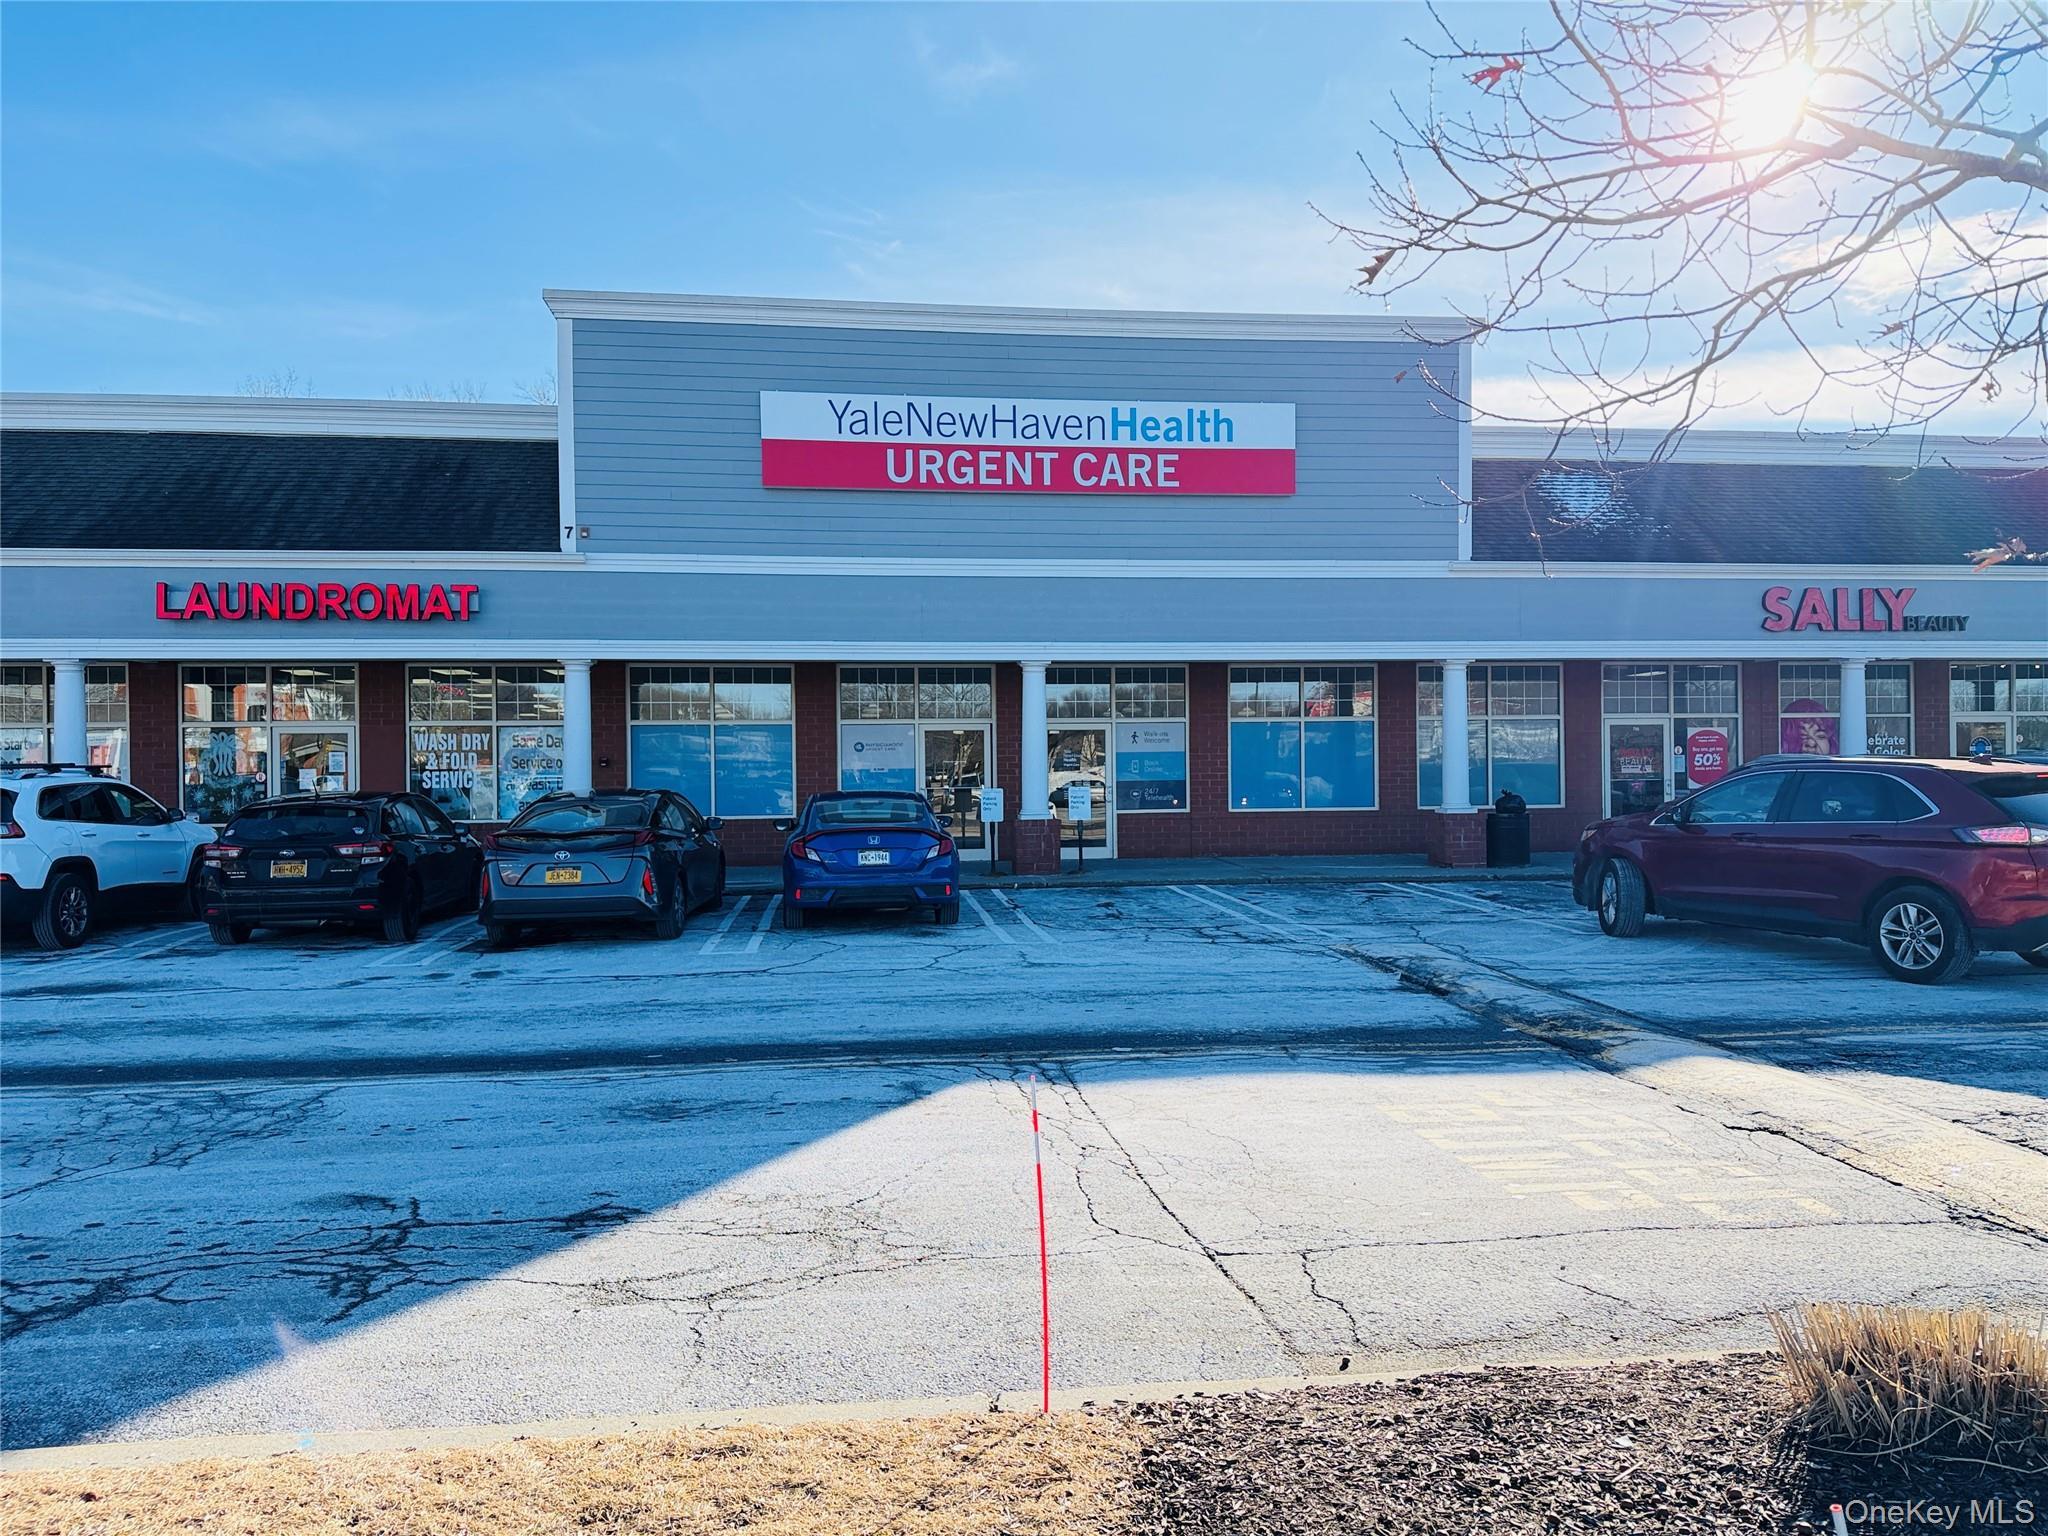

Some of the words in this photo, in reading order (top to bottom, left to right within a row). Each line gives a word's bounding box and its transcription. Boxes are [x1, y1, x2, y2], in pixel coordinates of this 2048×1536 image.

[886, 448, 1059, 486] URGENT
[1073, 453, 1180, 487] CARE
[564, 526, 573, 539] 7
[156, 582, 478, 621] LAUNDROMAT
[1762, 586, 1917, 632] SALLY
[1905, 615, 1970, 632] BEAUTY
[4, 737, 29, 751] Start
[415, 733, 457, 750] WASH
[461, 733, 490, 750] DRY
[512, 734, 543, 748] Same
[1868, 733, 1906, 745] ebrate
[426, 752, 438, 769] &
[440, 752, 478, 769] FOLD
[511, 755, 553, 769] Service
